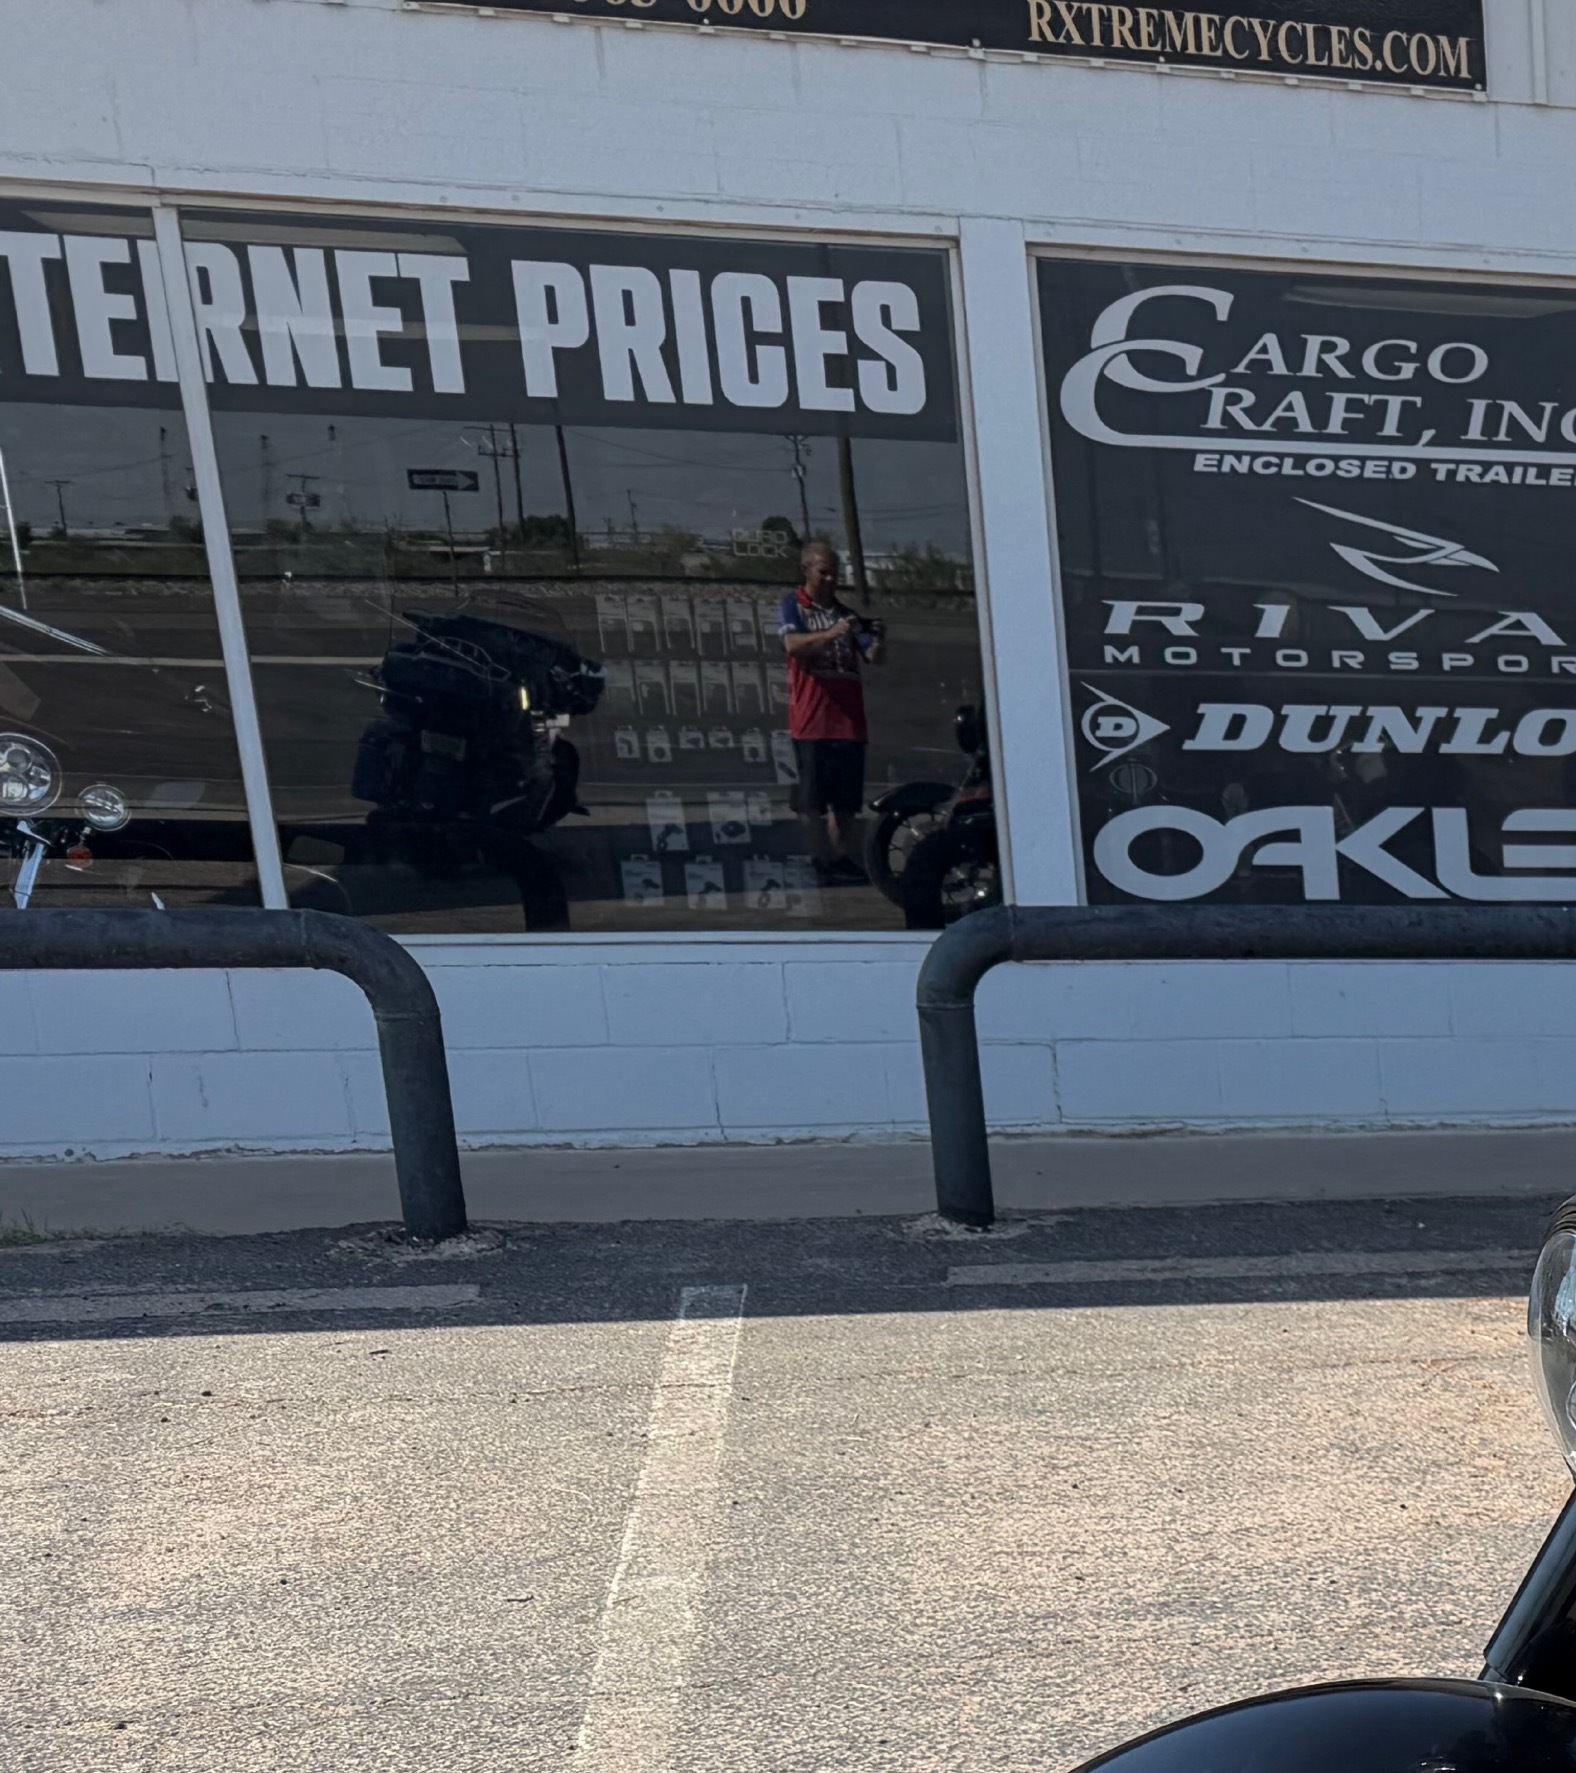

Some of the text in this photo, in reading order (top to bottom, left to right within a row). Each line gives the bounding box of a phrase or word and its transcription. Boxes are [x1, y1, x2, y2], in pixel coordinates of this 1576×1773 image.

[1028, 0, 1472, 79] RXTREMECYCLES.COM
[0, 230, 927, 415] TERNET PRICES
[1091, 285, 1489, 393] CARGO
[1193, 453, 1418, 481] ENCLOSED
[733, 542, 788, 558] LOCK
